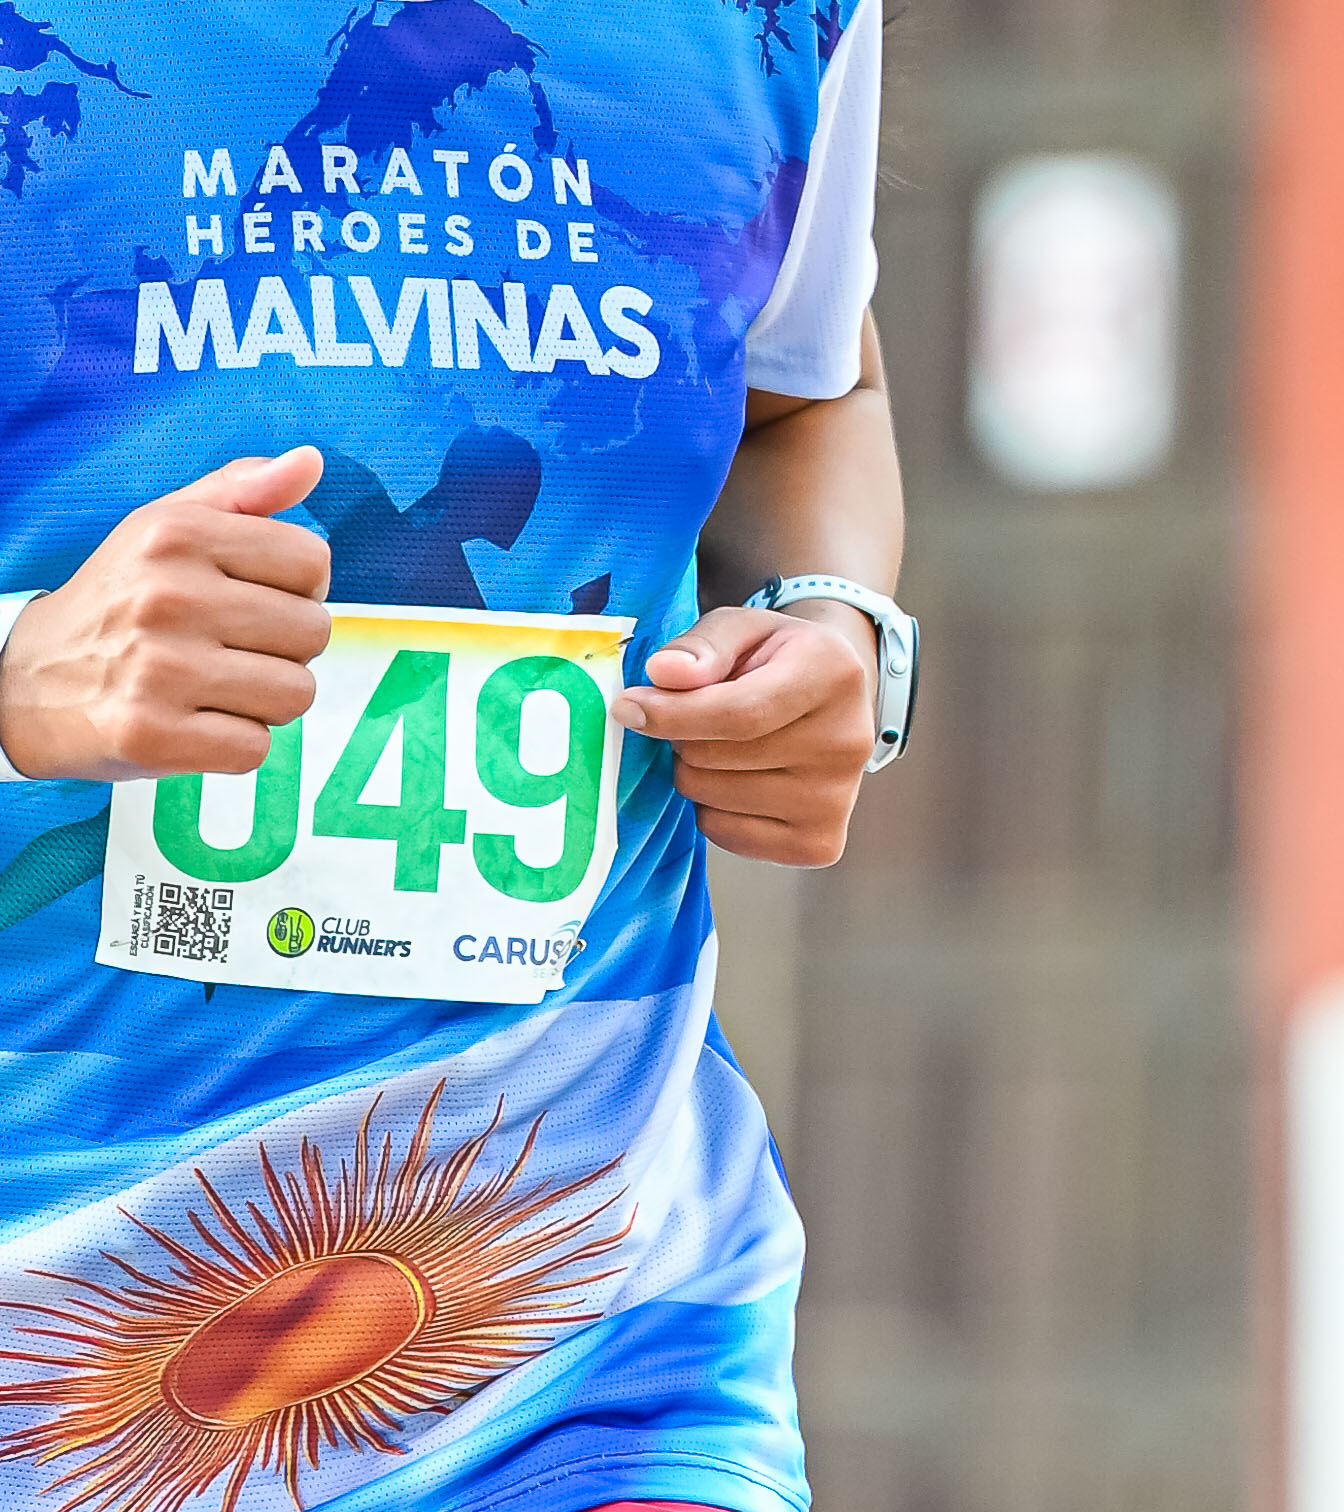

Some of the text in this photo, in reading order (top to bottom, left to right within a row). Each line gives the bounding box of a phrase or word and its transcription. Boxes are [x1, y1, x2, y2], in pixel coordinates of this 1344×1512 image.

[182, 143, 594, 206] MARATÓN
[185, 202, 599, 263] HÉROES DE
[133, 275, 661, 380] MALVINAS
[316, 934, 412, 958] RUNNER'S
[321, 916, 371, 936] CLUB
